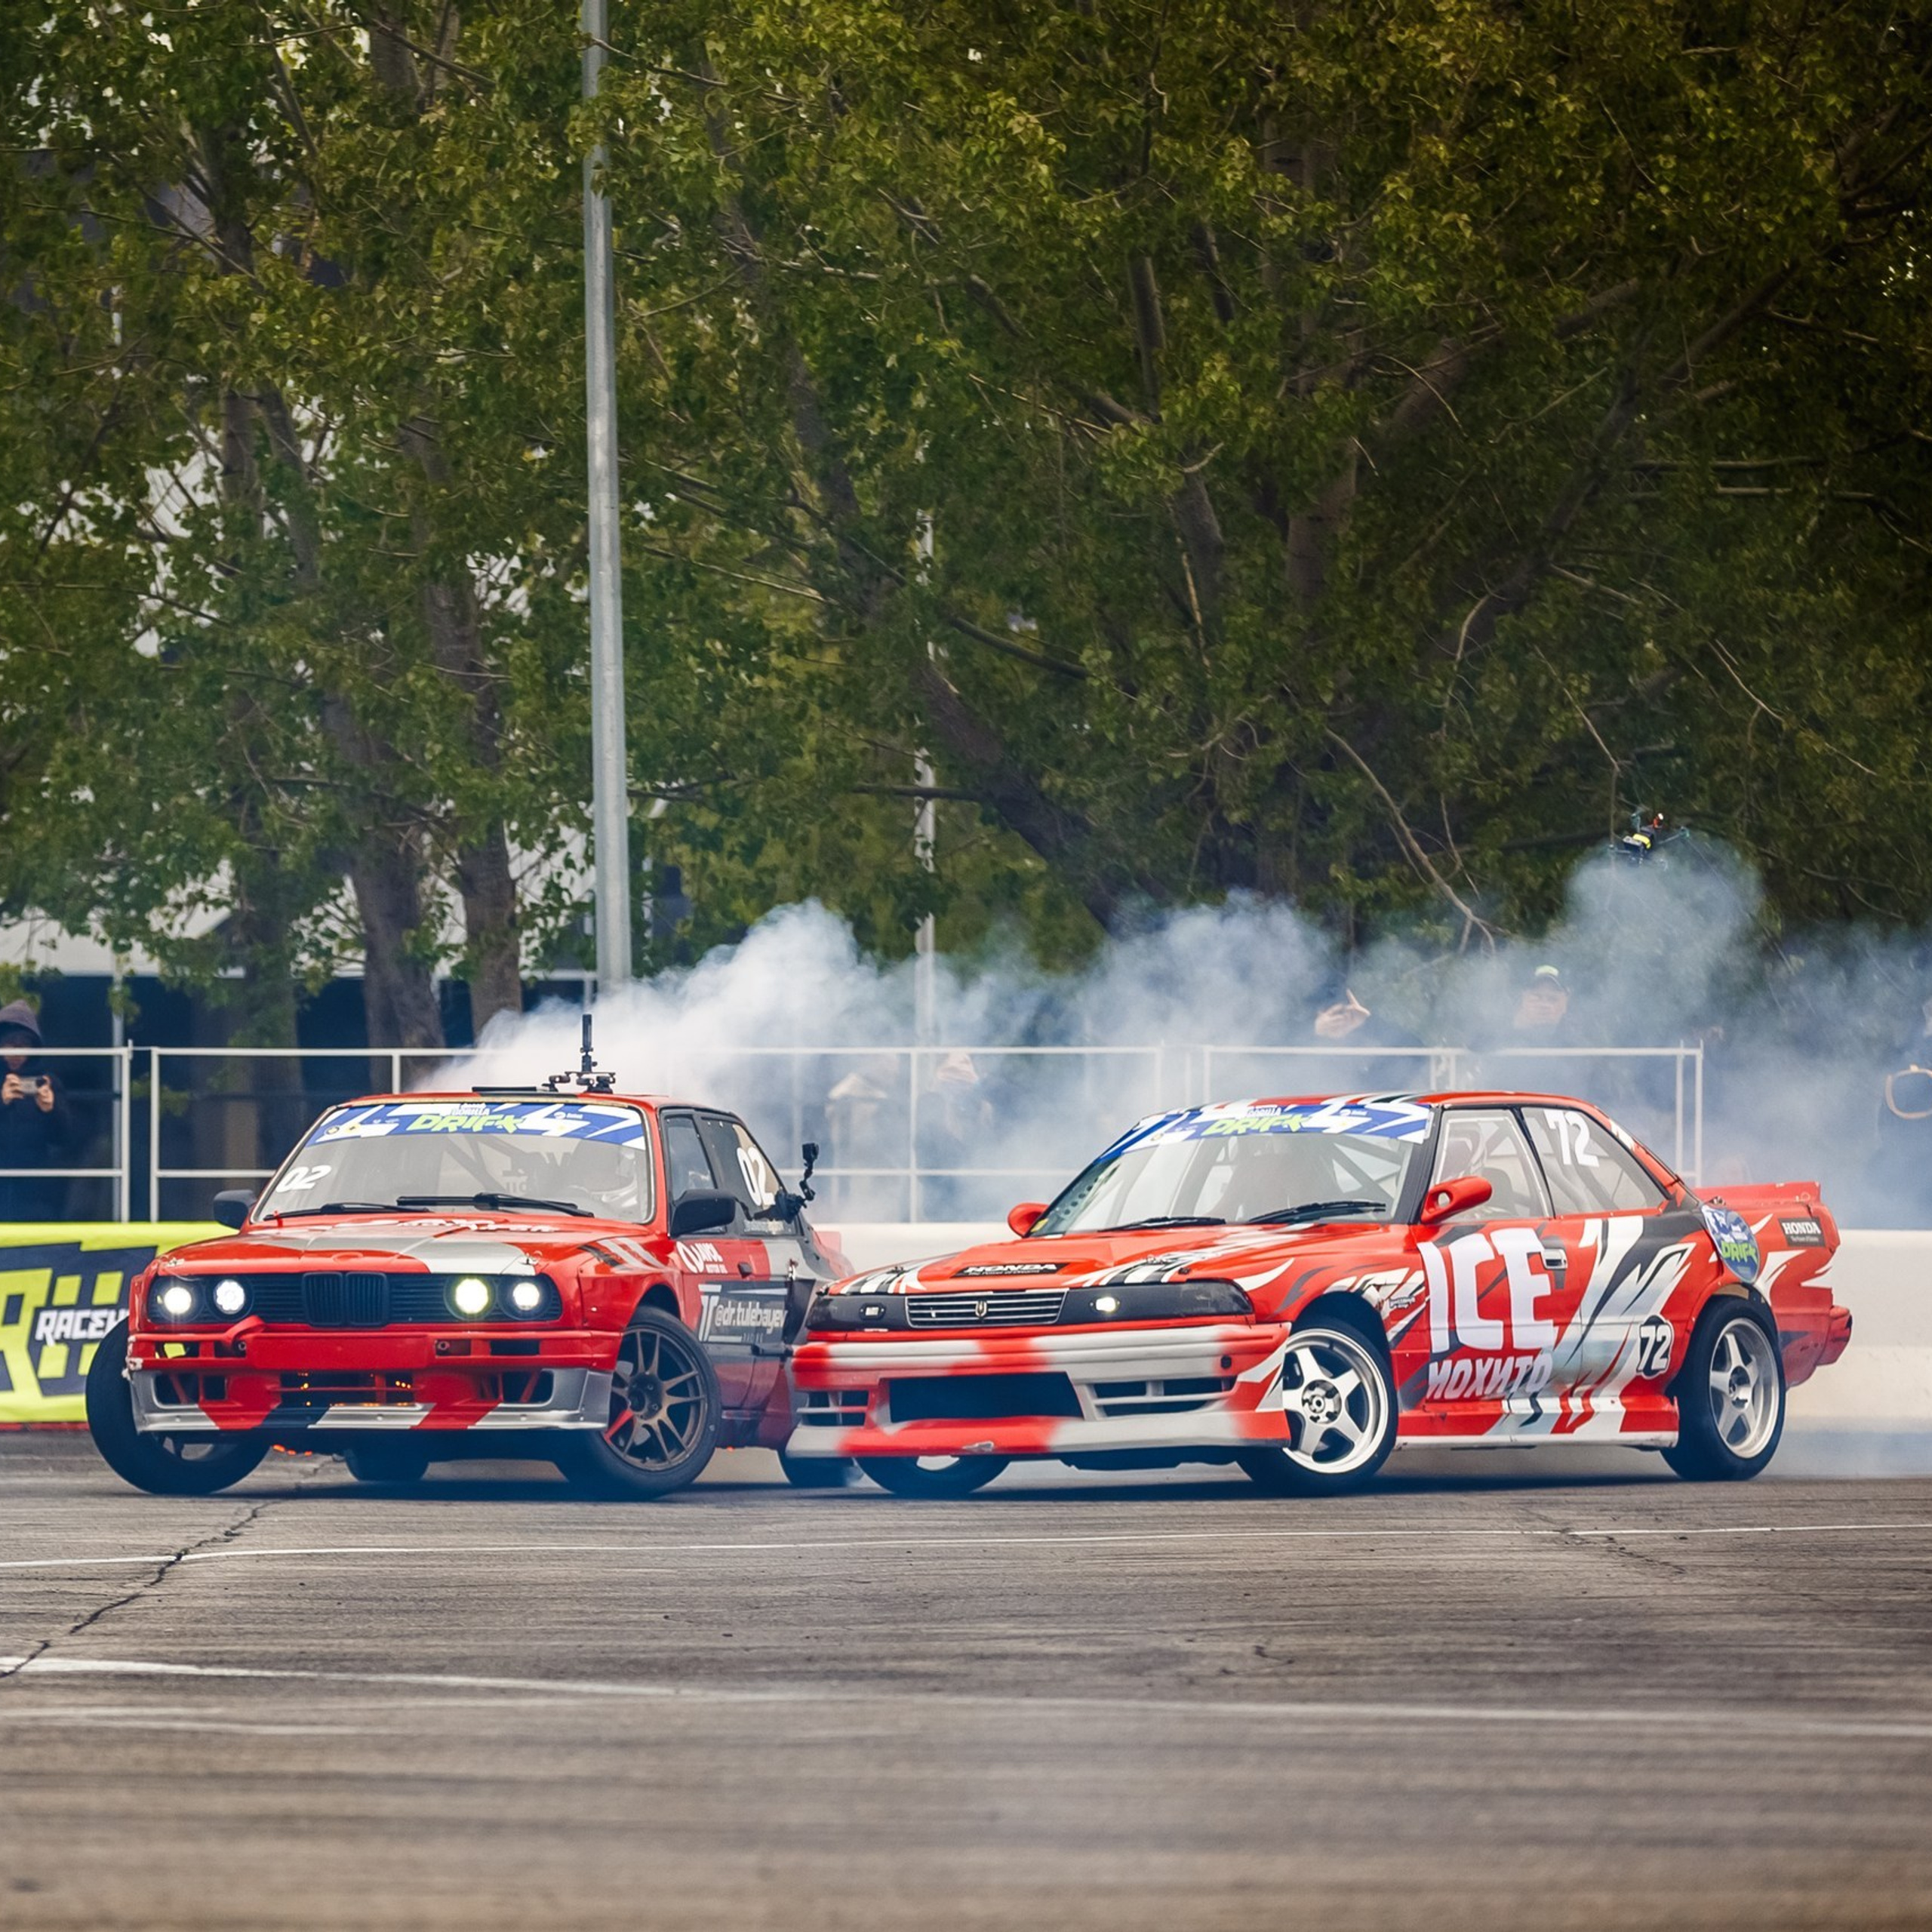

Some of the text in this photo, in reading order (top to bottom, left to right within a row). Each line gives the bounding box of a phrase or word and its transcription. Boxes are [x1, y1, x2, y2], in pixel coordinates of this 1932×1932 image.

[1543, 1109, 1599, 1168] 72
[275, 1164, 332, 1192] 02
[737, 1146, 777, 1206] 02
[1781, 1221, 1822, 1235] HONDA
[964, 1263, 1057, 1273] HONDA
[1417, 1227, 1557, 1354] ICE
[1638, 1324, 1672, 1371] 72
